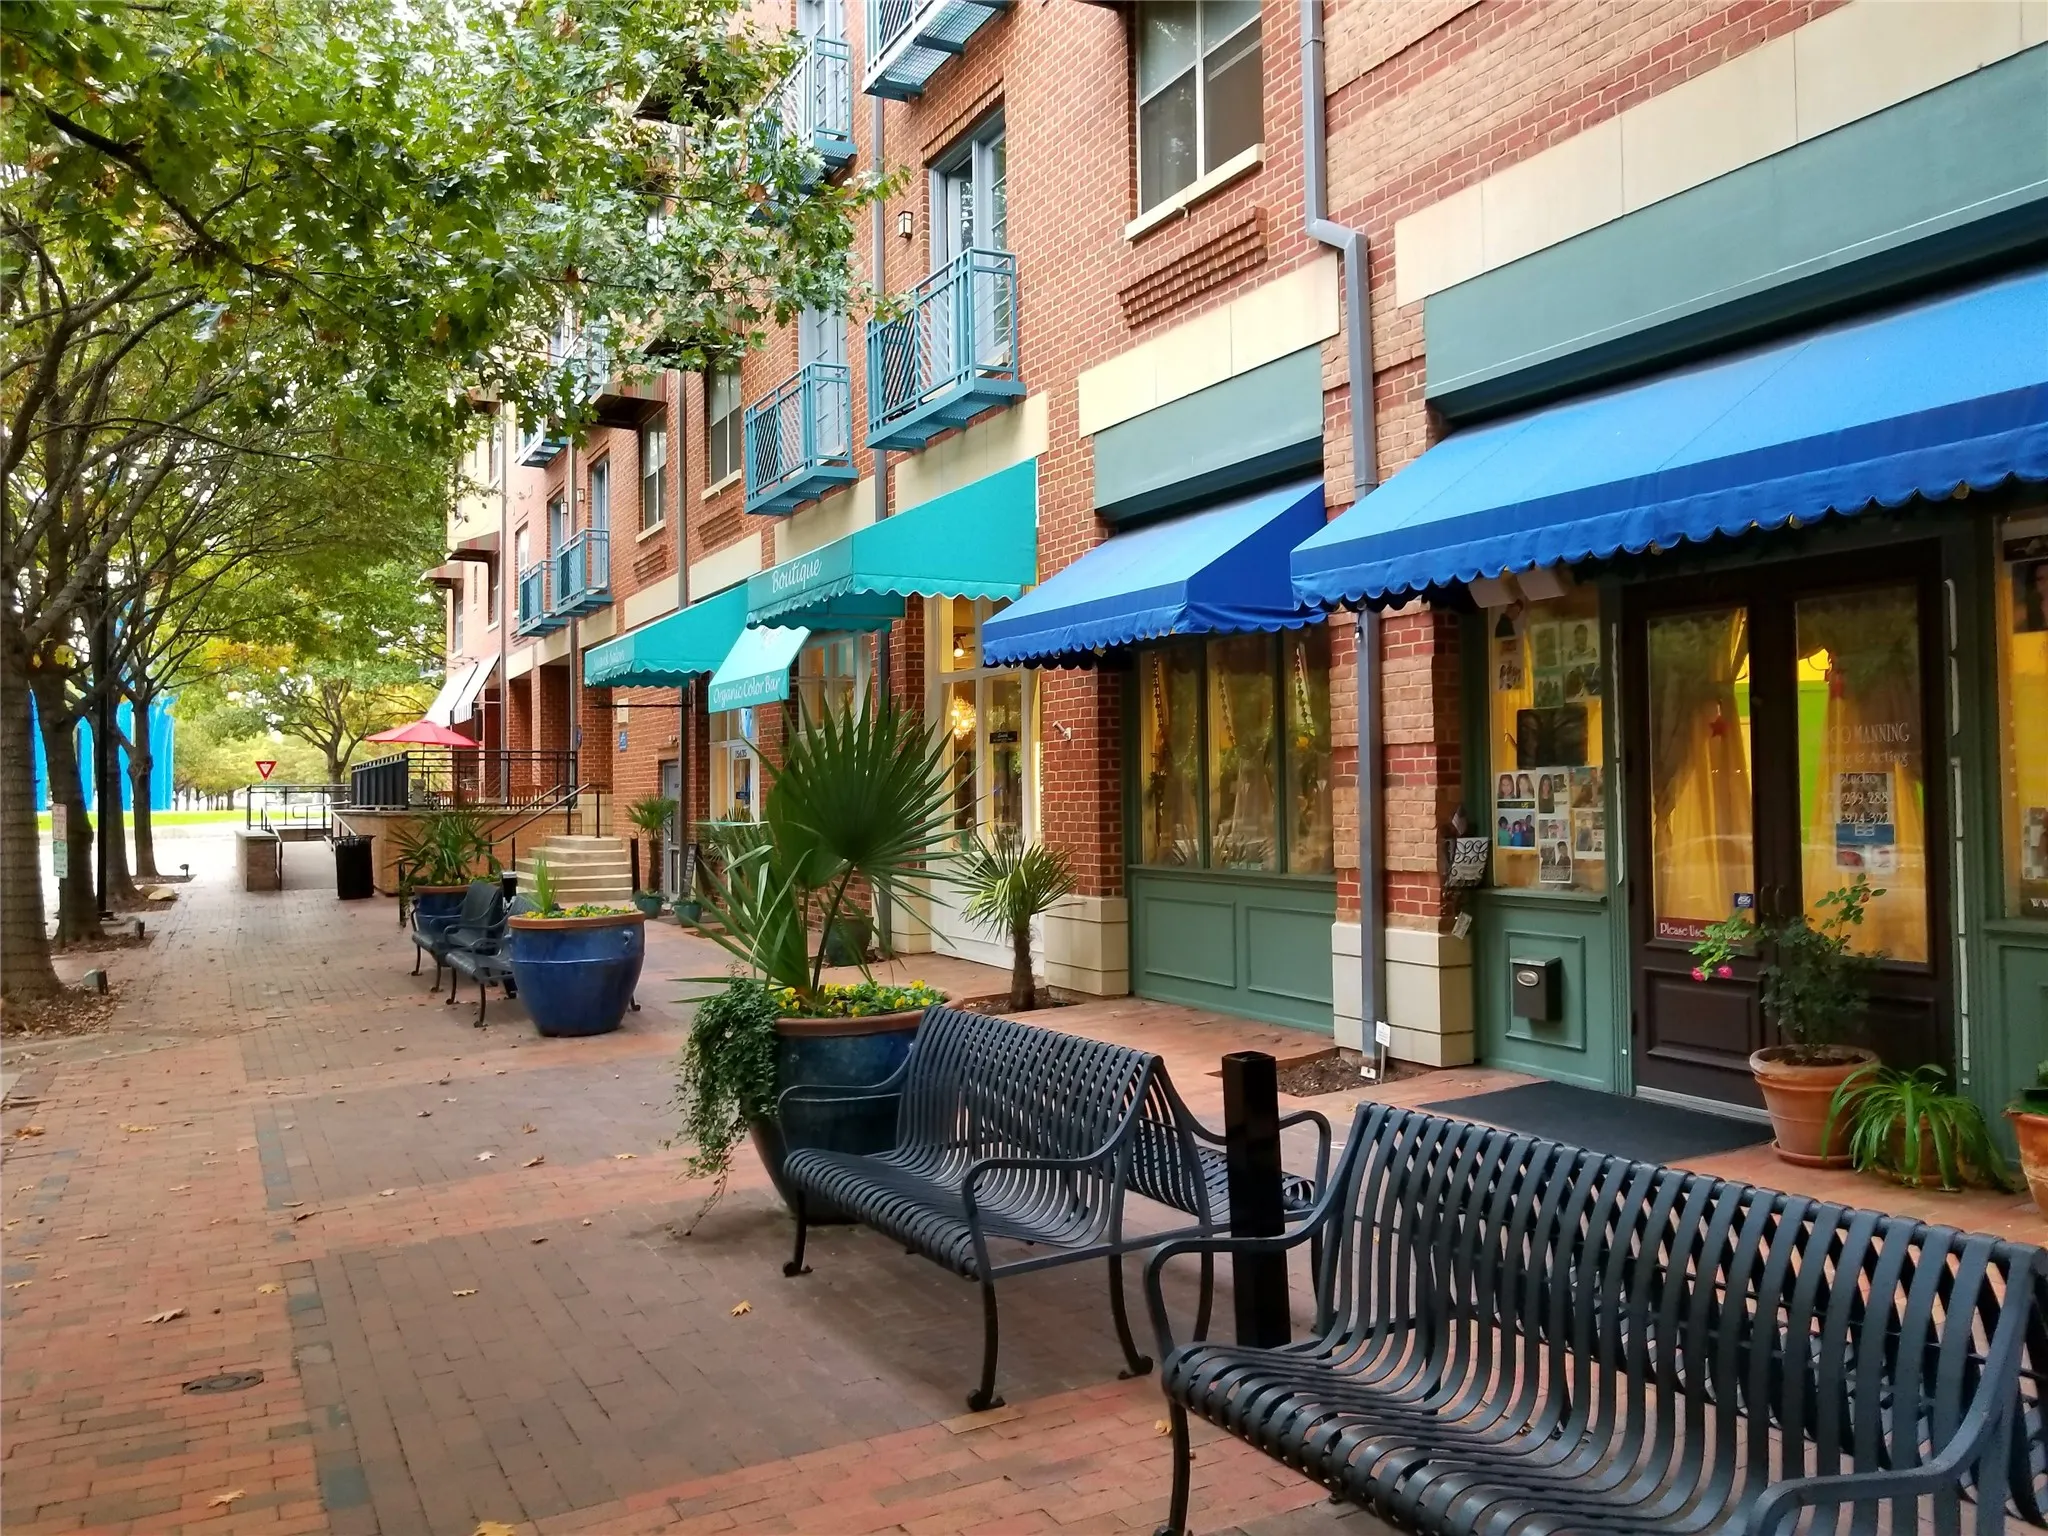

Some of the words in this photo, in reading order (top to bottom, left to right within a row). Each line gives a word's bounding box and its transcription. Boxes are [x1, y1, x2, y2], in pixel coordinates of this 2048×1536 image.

[771, 557, 822, 593] Boutique
[713, 684, 743, 708] Organic
[743, 676, 765, 698] Color
[765, 674, 781, 694] Bar
[1855, 722, 1909, 743] MANNING
[1660, 922, 1688, 936] Please
